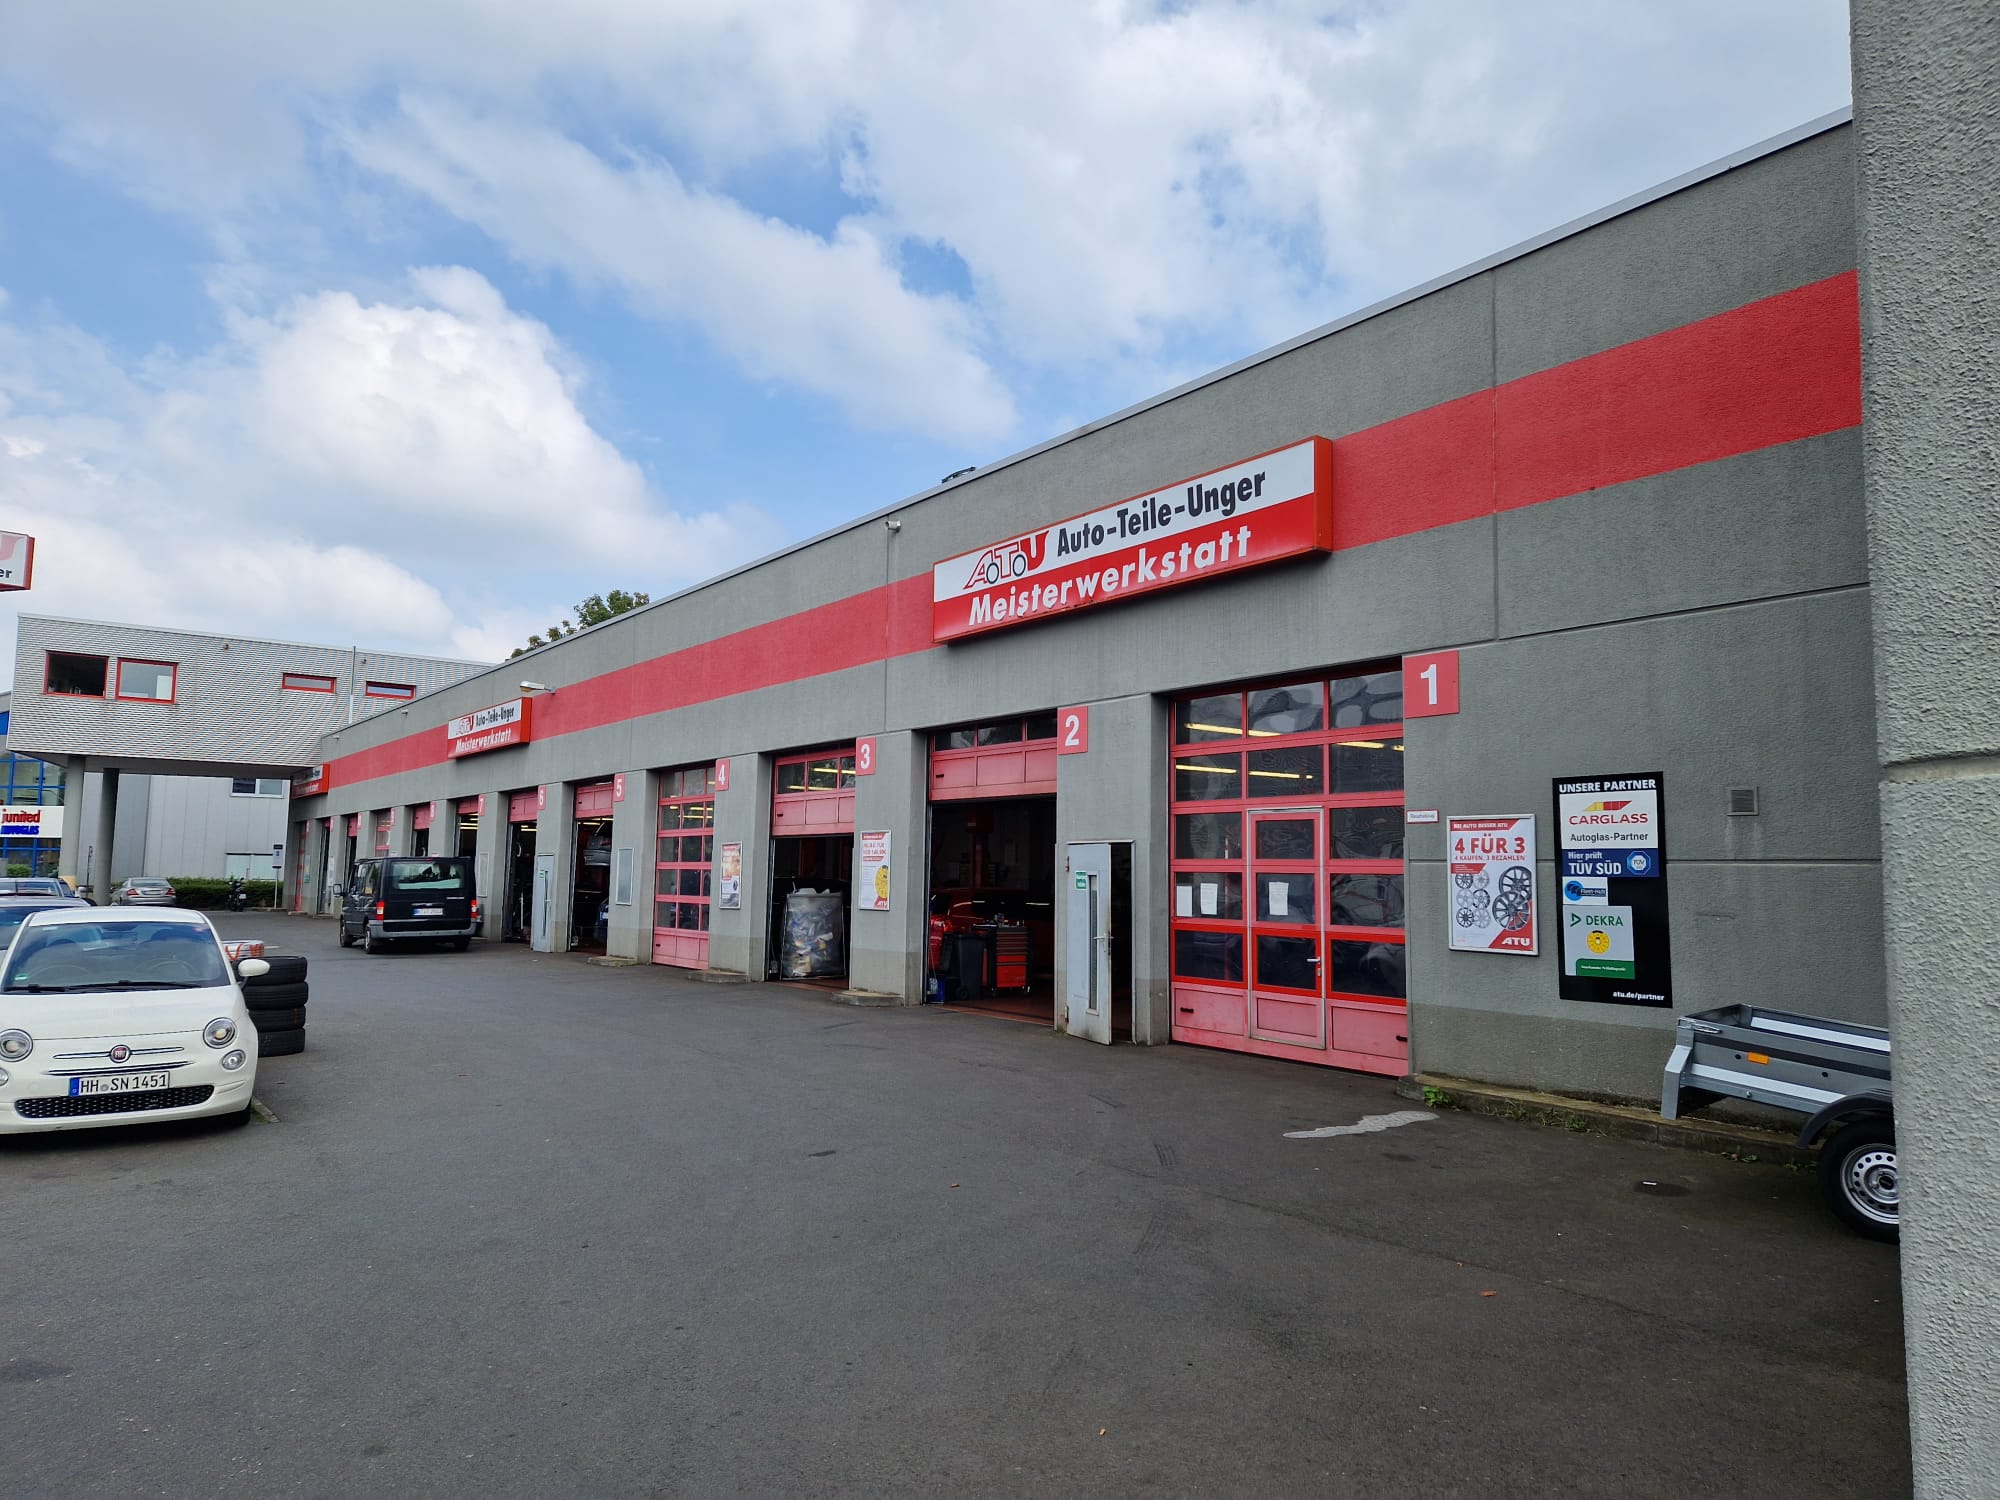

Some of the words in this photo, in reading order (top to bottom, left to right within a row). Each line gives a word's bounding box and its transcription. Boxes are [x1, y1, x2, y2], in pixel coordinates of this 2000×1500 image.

[1057, 471, 1266, 556] Auto-Teile-Unger
[968, 525, 1252, 626] Meisterwerkstatt
[1420, 664, 1438, 705] 1
[476, 706, 515, 726] Auto-Teile-Unger
[456, 727, 511, 752] Meisterwerkstatt
[1064, 715, 1080, 747] 2
[860, 743, 871, 769] 3
[718, 764, 726, 785] 4
[616, 779, 623, 797] 5
[1559, 782, 1601, 793] UNSERE
[1604, 779, 1656, 791] PARTNER
[538, 791, 544, 806] 6
[1, 809, 41, 823] junited
[1568, 813, 1648, 825] CARGLASS
[1455, 838, 1465, 853] 4
[1471, 833, 1508, 854] FÜR
[1514, 837, 1525, 853] 3
[1570, 832, 1648, 843] Autoglas-Partner
[1585, 851, 1602, 861] prüft
[1568, 860, 1592, 874] TÜV
[1596, 860, 1621, 874] SÜD
[1586, 915, 1623, 926] DEKRA
[1501, 937, 1531, 946] ATU
[1613, 991, 1664, 1001] atu.de/partner
[80, 1080, 99, 1093] HH
[110, 1077, 129, 1091] SN
[133, 1074, 166, 1089] 1451
